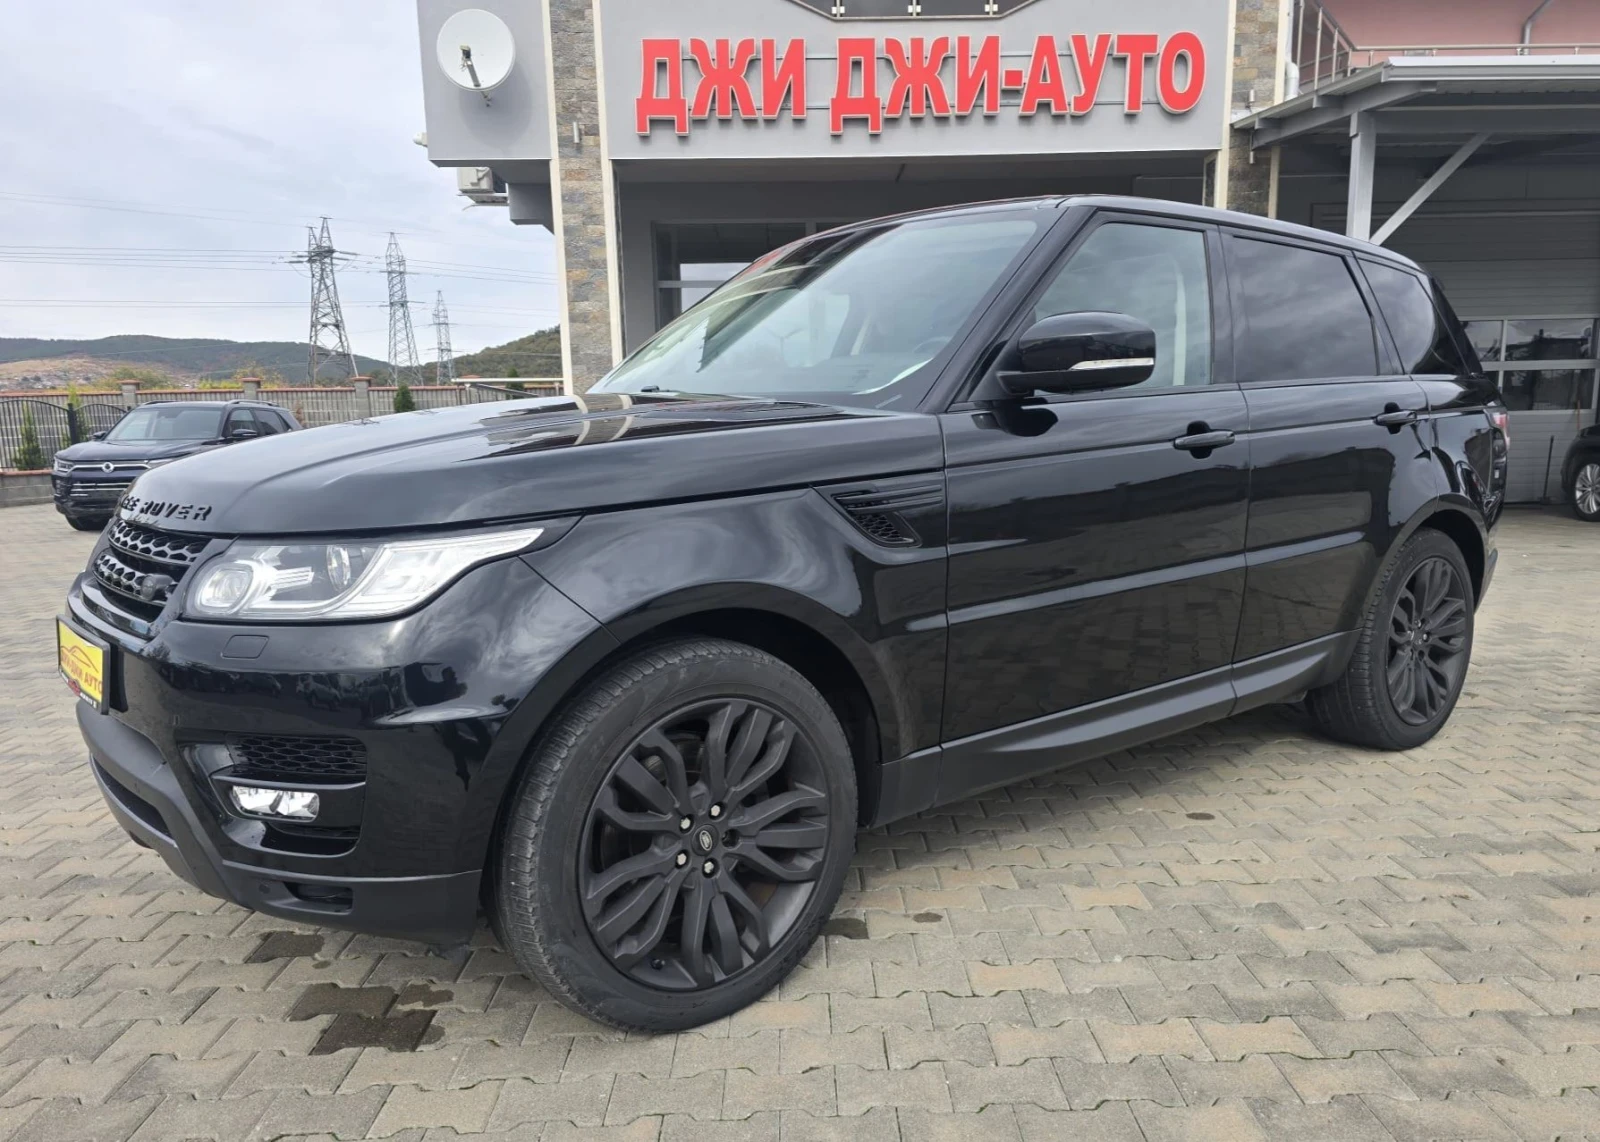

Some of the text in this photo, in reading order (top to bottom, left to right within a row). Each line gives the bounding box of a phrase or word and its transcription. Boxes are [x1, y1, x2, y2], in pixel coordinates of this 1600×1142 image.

[635, 31, 1206, 137] ДЖИ ДЖИ-АУТО
[140, 500, 212, 521] ROVER
